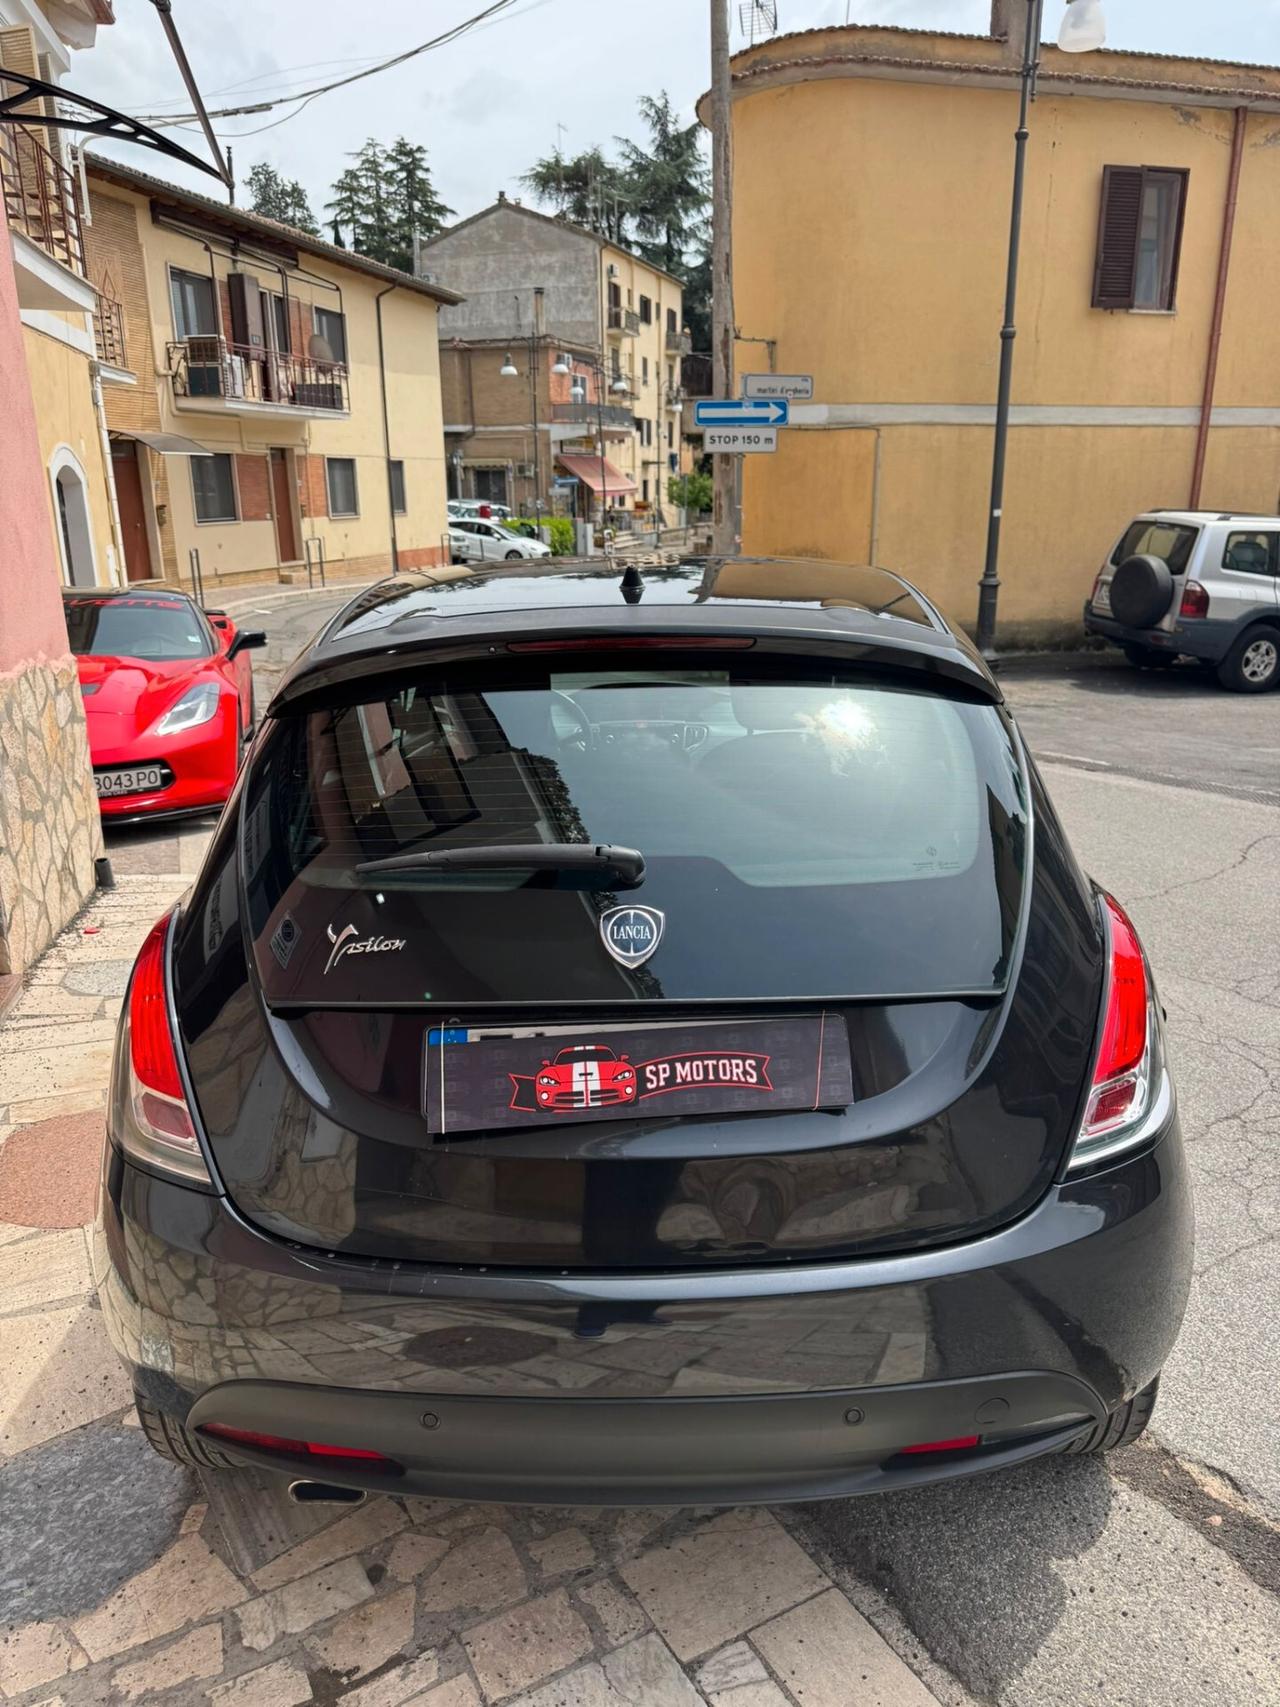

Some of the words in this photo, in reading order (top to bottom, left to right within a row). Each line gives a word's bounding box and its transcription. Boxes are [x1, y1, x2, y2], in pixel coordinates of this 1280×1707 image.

[709, 435, 739, 445] STOP
[742, 435, 761, 445] 150
[764, 437, 773, 445] m
[613, 925, 652, 940] LANCIA
[323, 922, 407, 975] Ypsilon
[645, 1063, 671, 1089] SP
[675, 1058, 758, 1084] MOTORS
